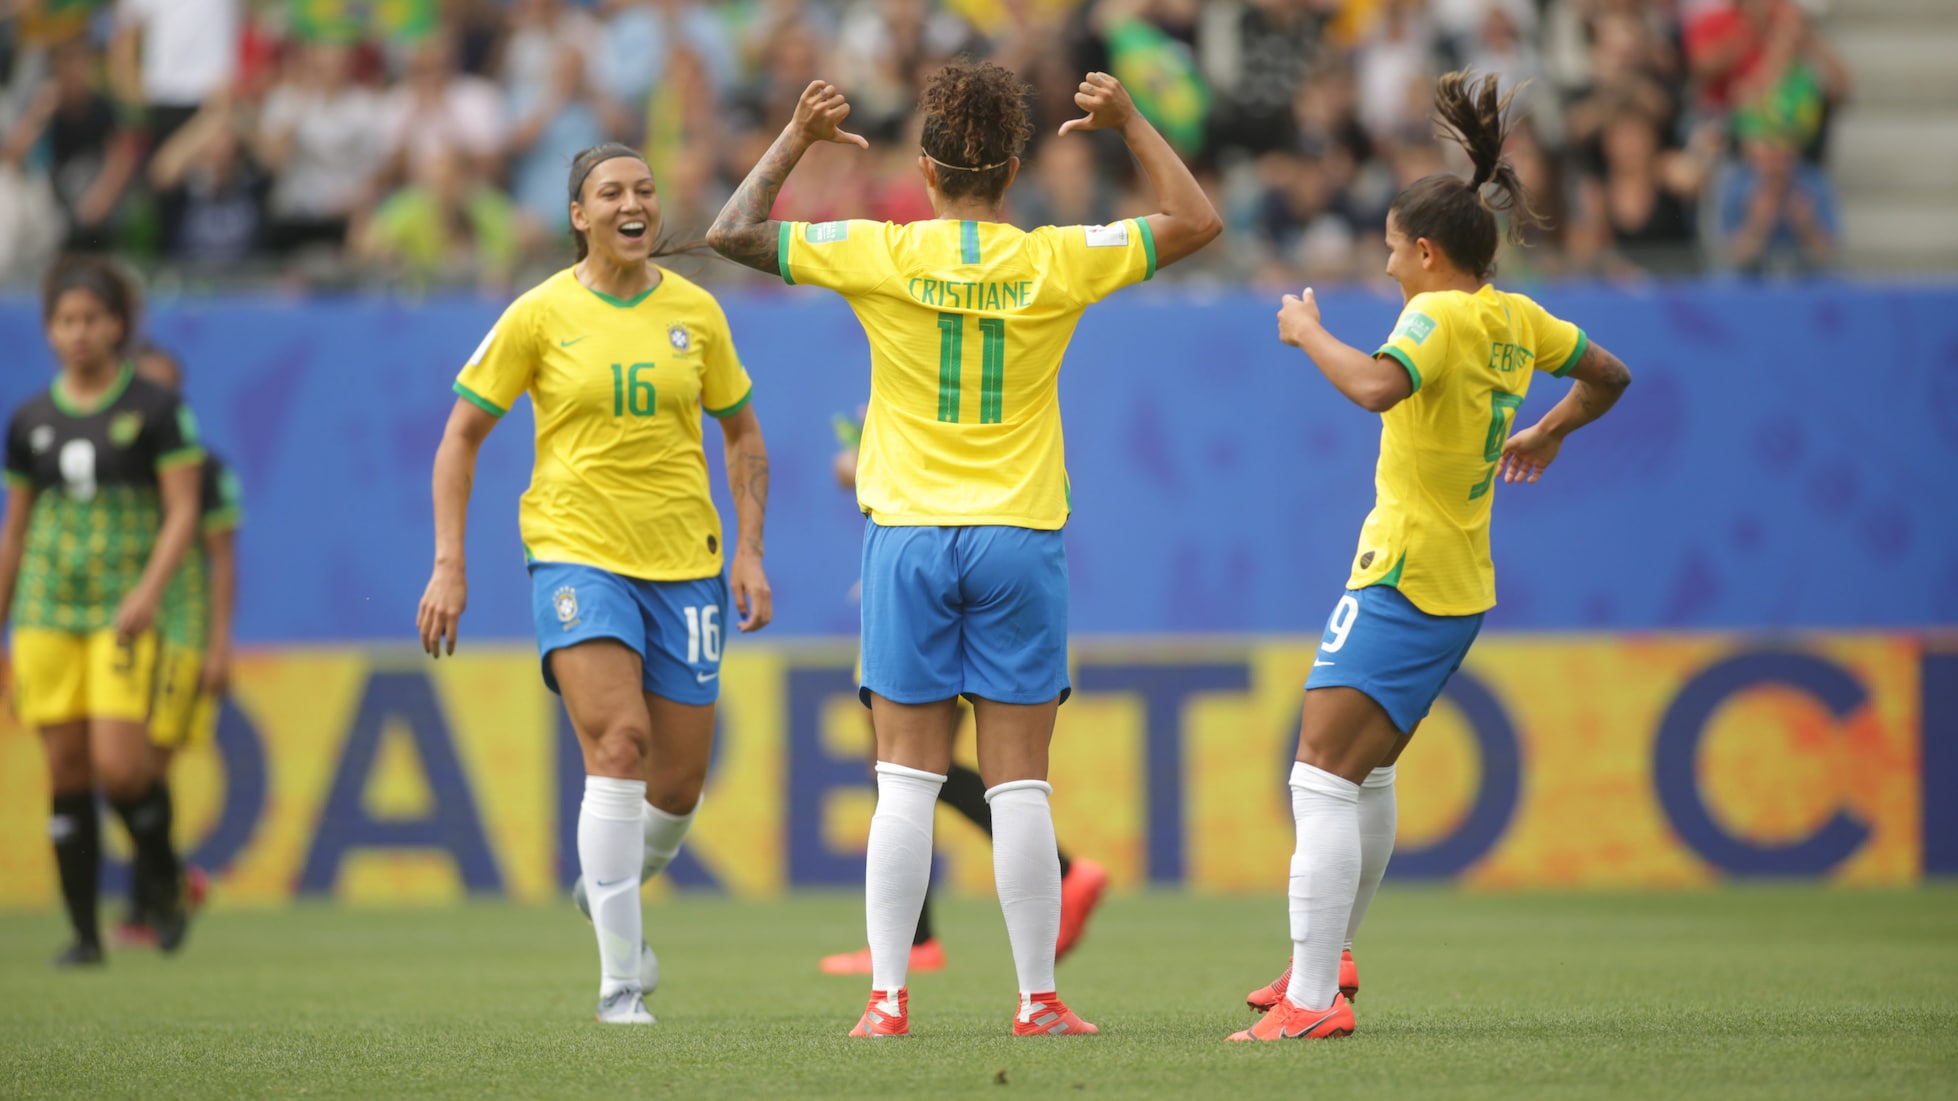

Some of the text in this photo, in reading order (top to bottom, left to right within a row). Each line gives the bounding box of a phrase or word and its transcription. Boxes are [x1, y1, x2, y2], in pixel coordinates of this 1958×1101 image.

[908, 277, 1033, 311] CRISTIANE
[611, 362, 656, 417] 16
[937, 311, 1005, 424] 11
[683, 604, 720, 664] 16
[1320, 594, 1359, 653] 9
[1074, 657, 1523, 888] TO
